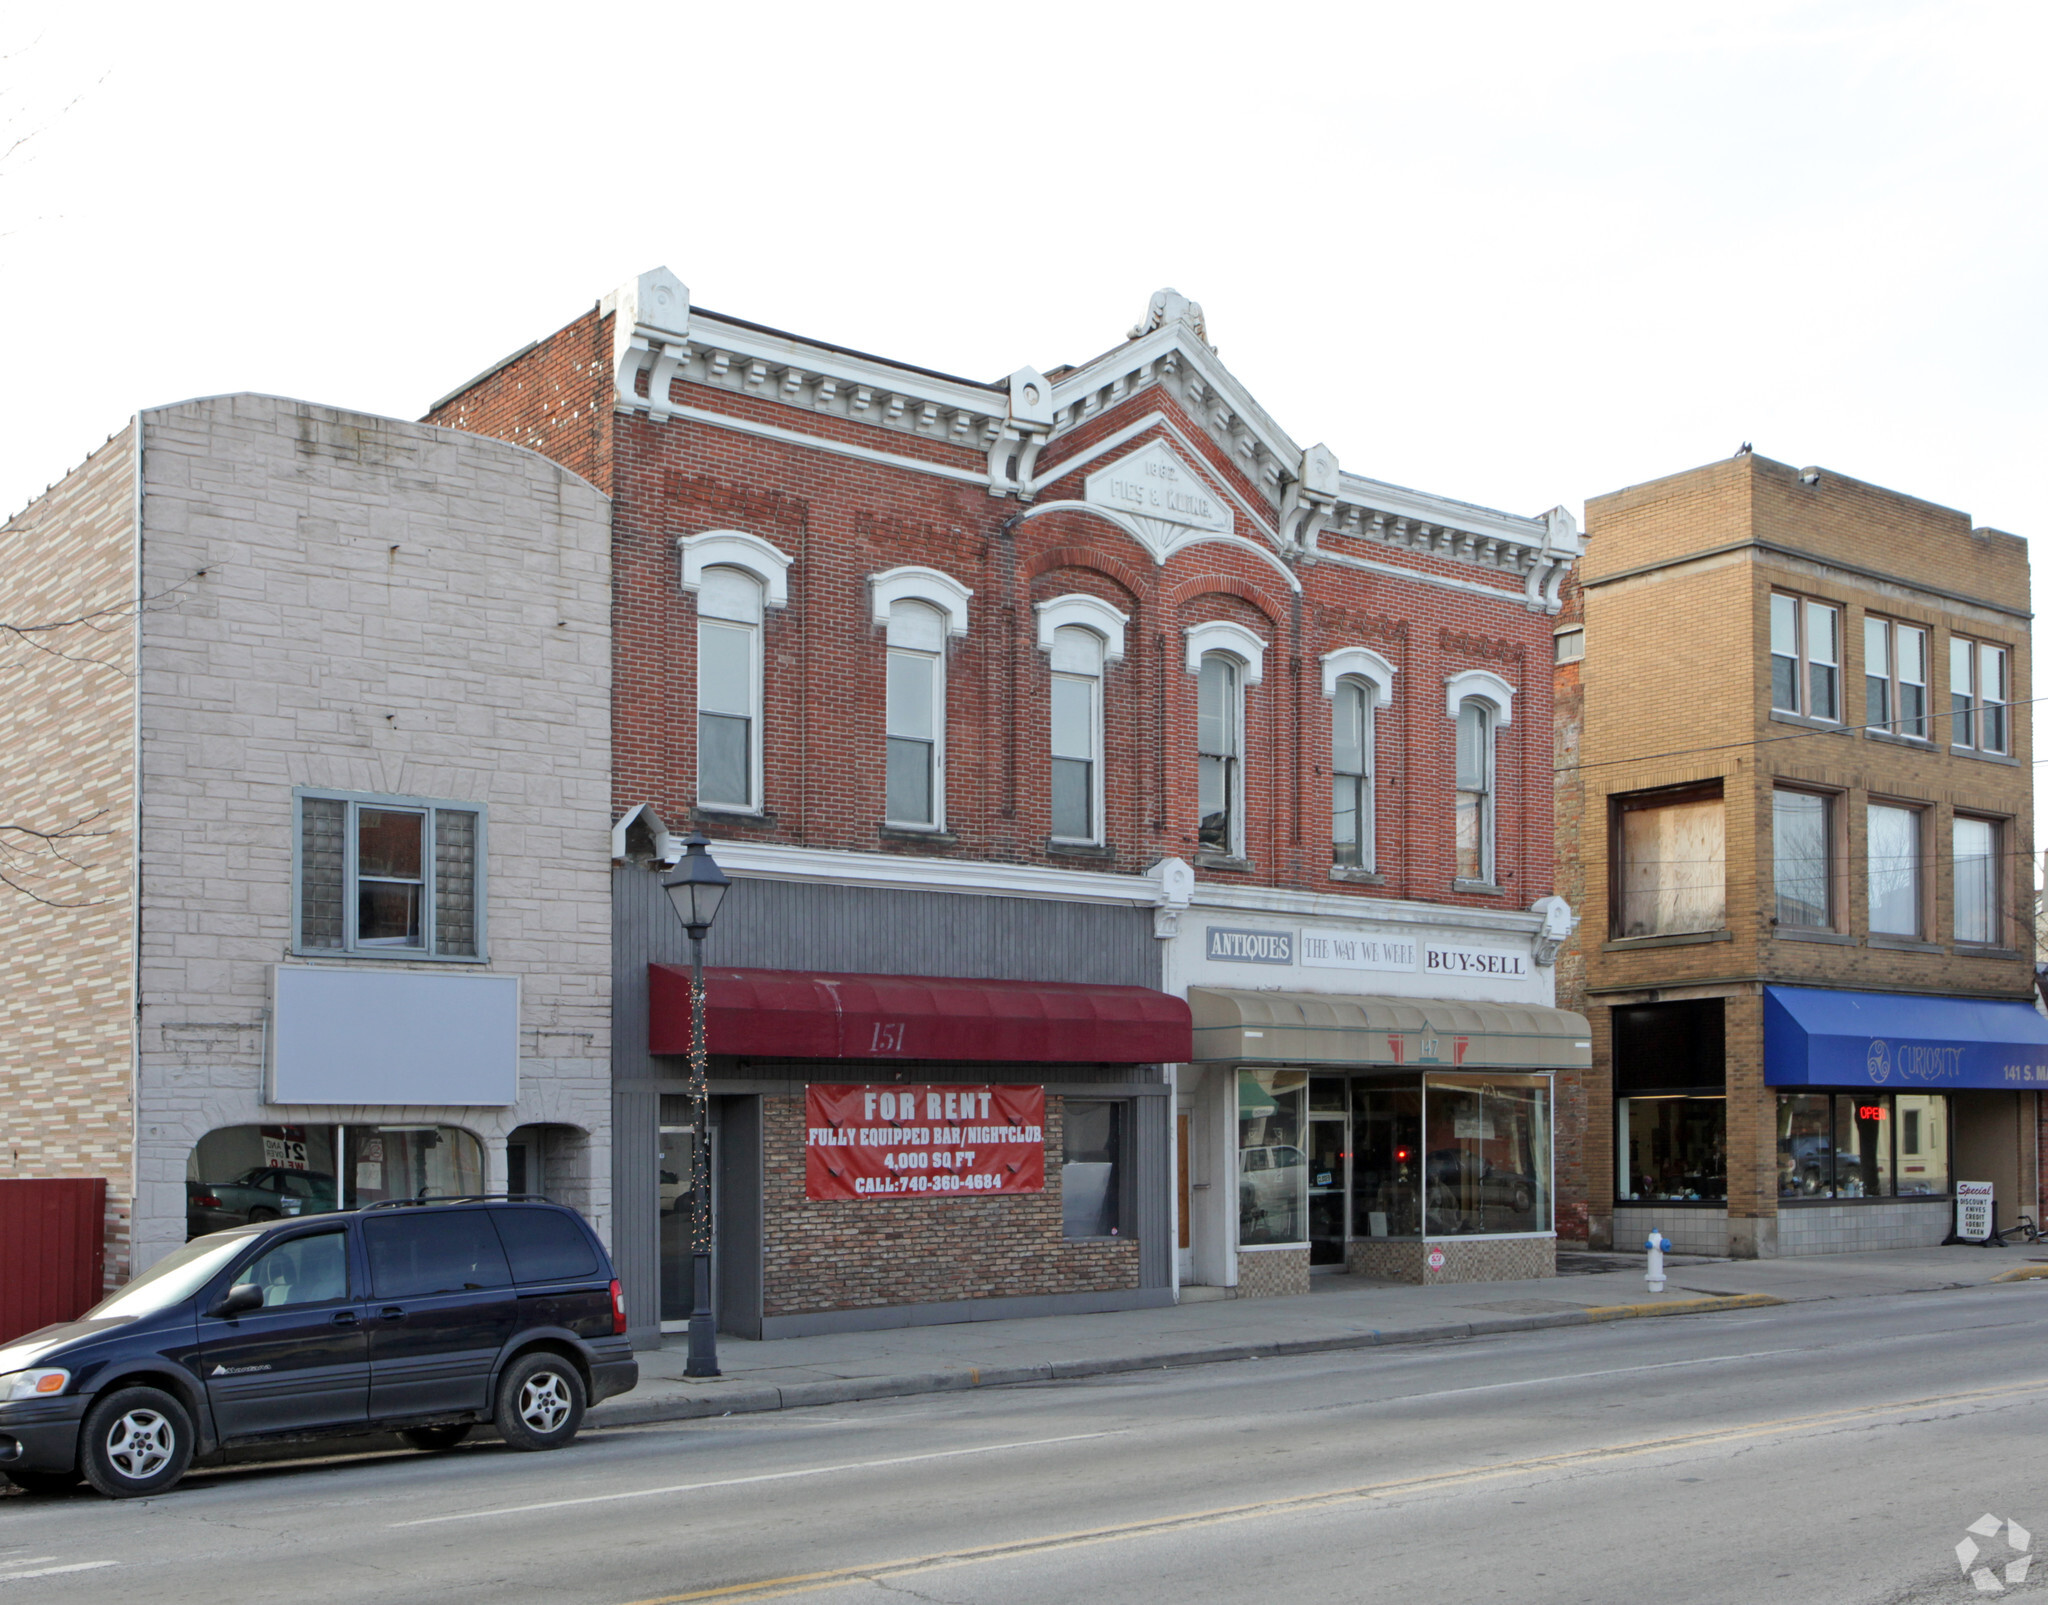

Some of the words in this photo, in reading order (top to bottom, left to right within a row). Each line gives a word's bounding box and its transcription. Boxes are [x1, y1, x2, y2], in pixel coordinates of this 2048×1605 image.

[1150, 487, 1161, 506] &
[1212, 932, 1290, 961] ANTIQUES
[1305, 938, 1329, 959] THE
[1333, 940, 1357, 961] WAY
[1361, 942, 1379, 962] WE
[1383, 943, 1415, 964] WERE
[1427, 950, 1526, 975] BUY-SELL
[869, 1022, 905, 1052] 151
[1421, 1039, 1439, 1056] 147
[1897, 1045, 1966, 1081] CURIOSITY
[2003, 1065, 2021, 1081] 141
[2024, 1064, 2034, 1081] S.
[2036, 1065, 2048, 1081] M
[864, 1092, 916, 1120] FOR
[927, 1092, 992, 1120] RENT
[1859, 1106, 1887, 1120] OPEN
[808, 1128, 856, 1146] FULLY
[860, 1127, 930, 1147] EQUIPPED
[933, 1126, 1042, 1148] BAR/NIGHTCLUB
[884, 1152, 929, 1170] 4,000
[932, 1152, 952, 1169] SQ
[956, 1151, 976, 1168] FT
[1958, 1184, 1991, 1197] Special
